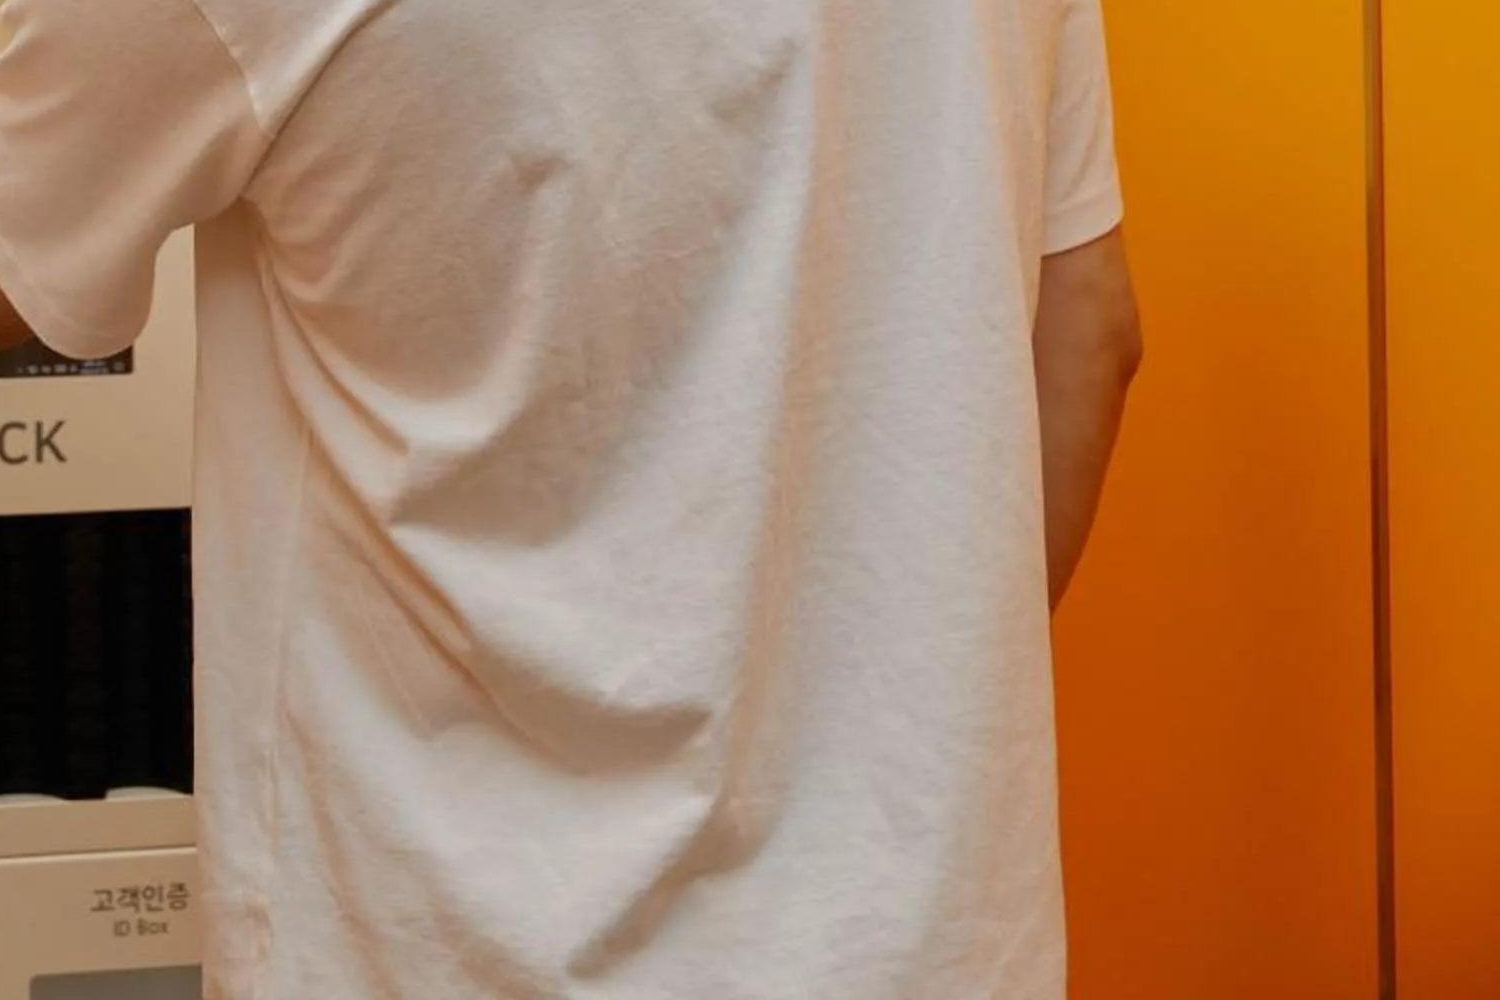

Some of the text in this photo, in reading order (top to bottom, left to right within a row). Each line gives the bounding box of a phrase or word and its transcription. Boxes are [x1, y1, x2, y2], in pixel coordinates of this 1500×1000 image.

[90, 882, 191, 914] 고객인증
[113, 918, 170, 938] ID Box
